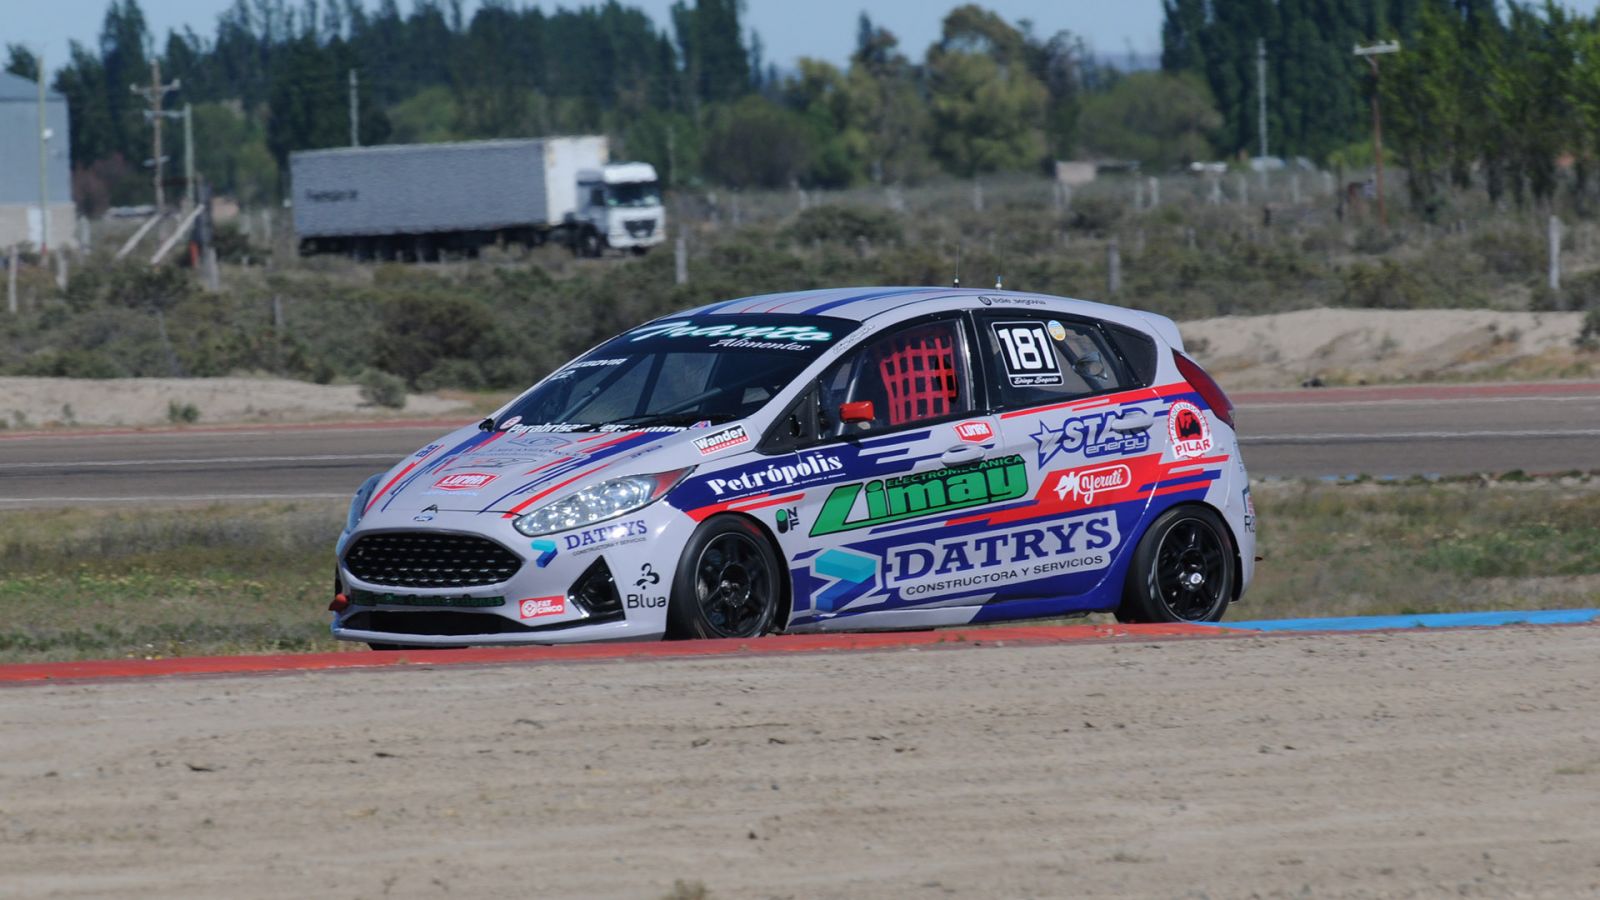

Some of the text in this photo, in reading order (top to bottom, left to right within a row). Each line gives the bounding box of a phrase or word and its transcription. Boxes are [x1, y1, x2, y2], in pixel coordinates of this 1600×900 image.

[998, 328, 1055, 370] 181
[695, 426, 745, 450] Wander
[1086, 437, 1148, 455] energy
[1175, 439, 1211, 456] PILAR
[706, 454, 843, 496] Petrópolis
[809, 461, 1029, 538] Limay
[894, 516, 1113, 582] DATRYS
[905, 554, 1104, 596] CONSTRUCTORA Y SERVICIOS
[626, 593, 667, 609] Blua
